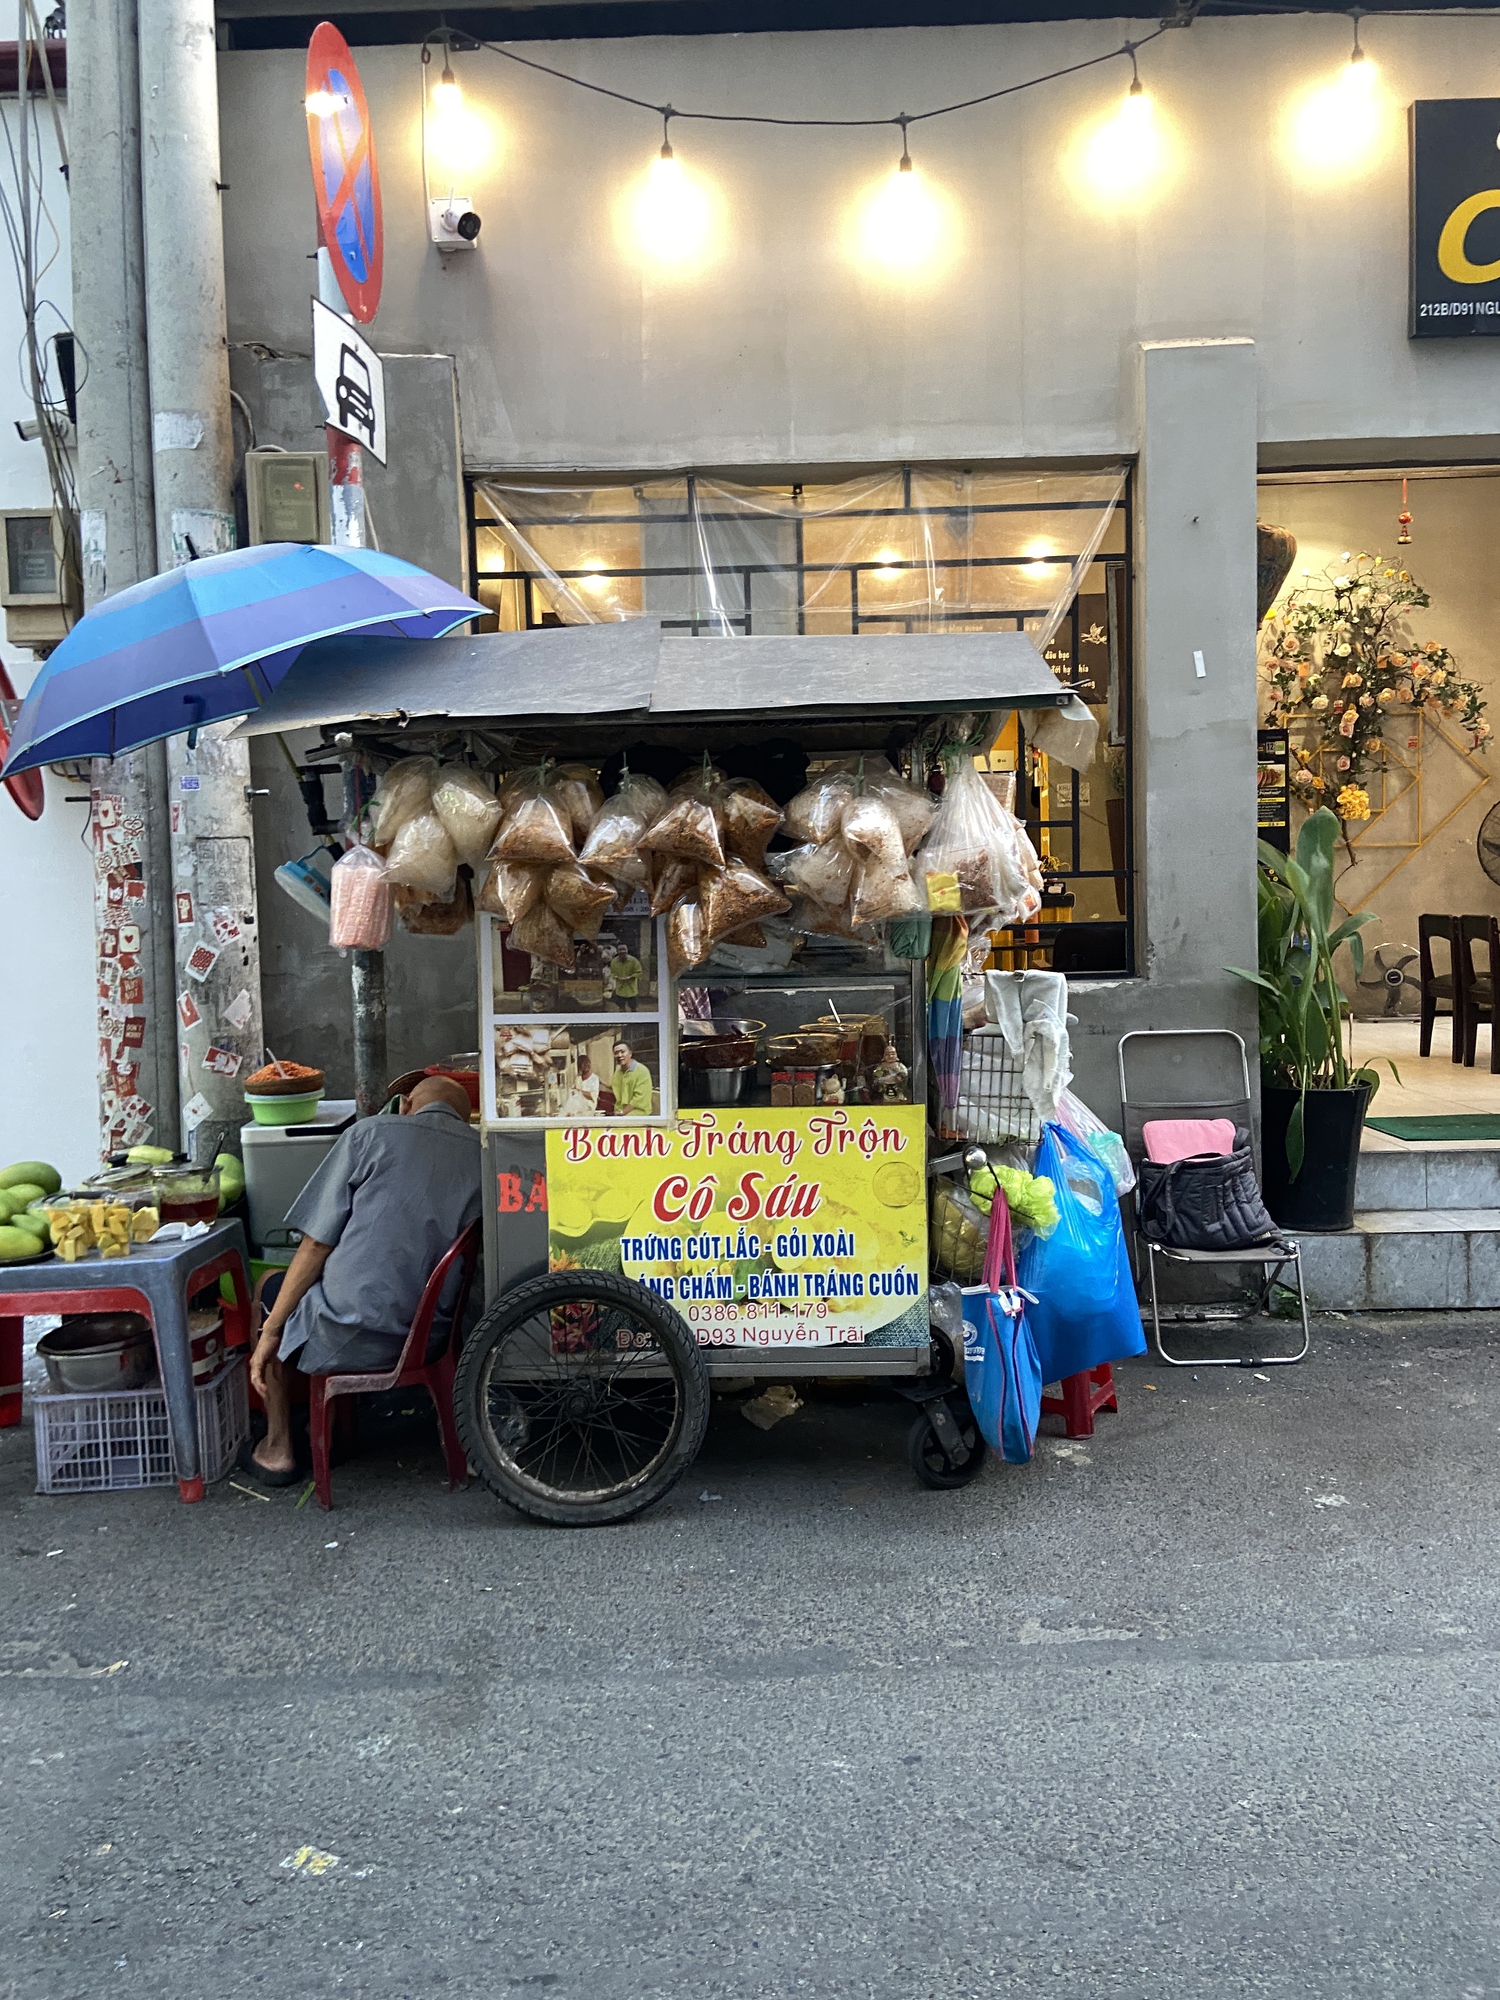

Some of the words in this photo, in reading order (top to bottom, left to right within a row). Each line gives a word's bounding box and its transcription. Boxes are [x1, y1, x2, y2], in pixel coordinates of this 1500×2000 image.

[1420, 302, 1474, 317] 212B/D91
[564, 1127, 671, 1161] Bánh
[678, 1112, 802, 1165] Tráng
[810, 1112, 907, 1160] Trộn
[654, 1175, 718, 1222] Cô
[728, 1171, 821, 1222] Sáu
[622, 1233, 681, 1261] TRỨNG
[688, 1232, 721, 1259] CÚT
[726, 1229, 759, 1258] LẮC
[778, 1227, 807, 1257] GỎI
[812, 1226, 854, 1256] XOÀI
[679, 1268, 732, 1299] CHẤM
[749, 1266, 798, 1298] BÁNH
[804, 1267, 863, 1297] TRÁNG
[869, 1263, 919, 1296] CUỐN
[689, 1303, 827, 1322] 0386.811.179
[743, 1323, 818, 1347] Nguyễn
[825, 1325, 864, 1343] Trãi
